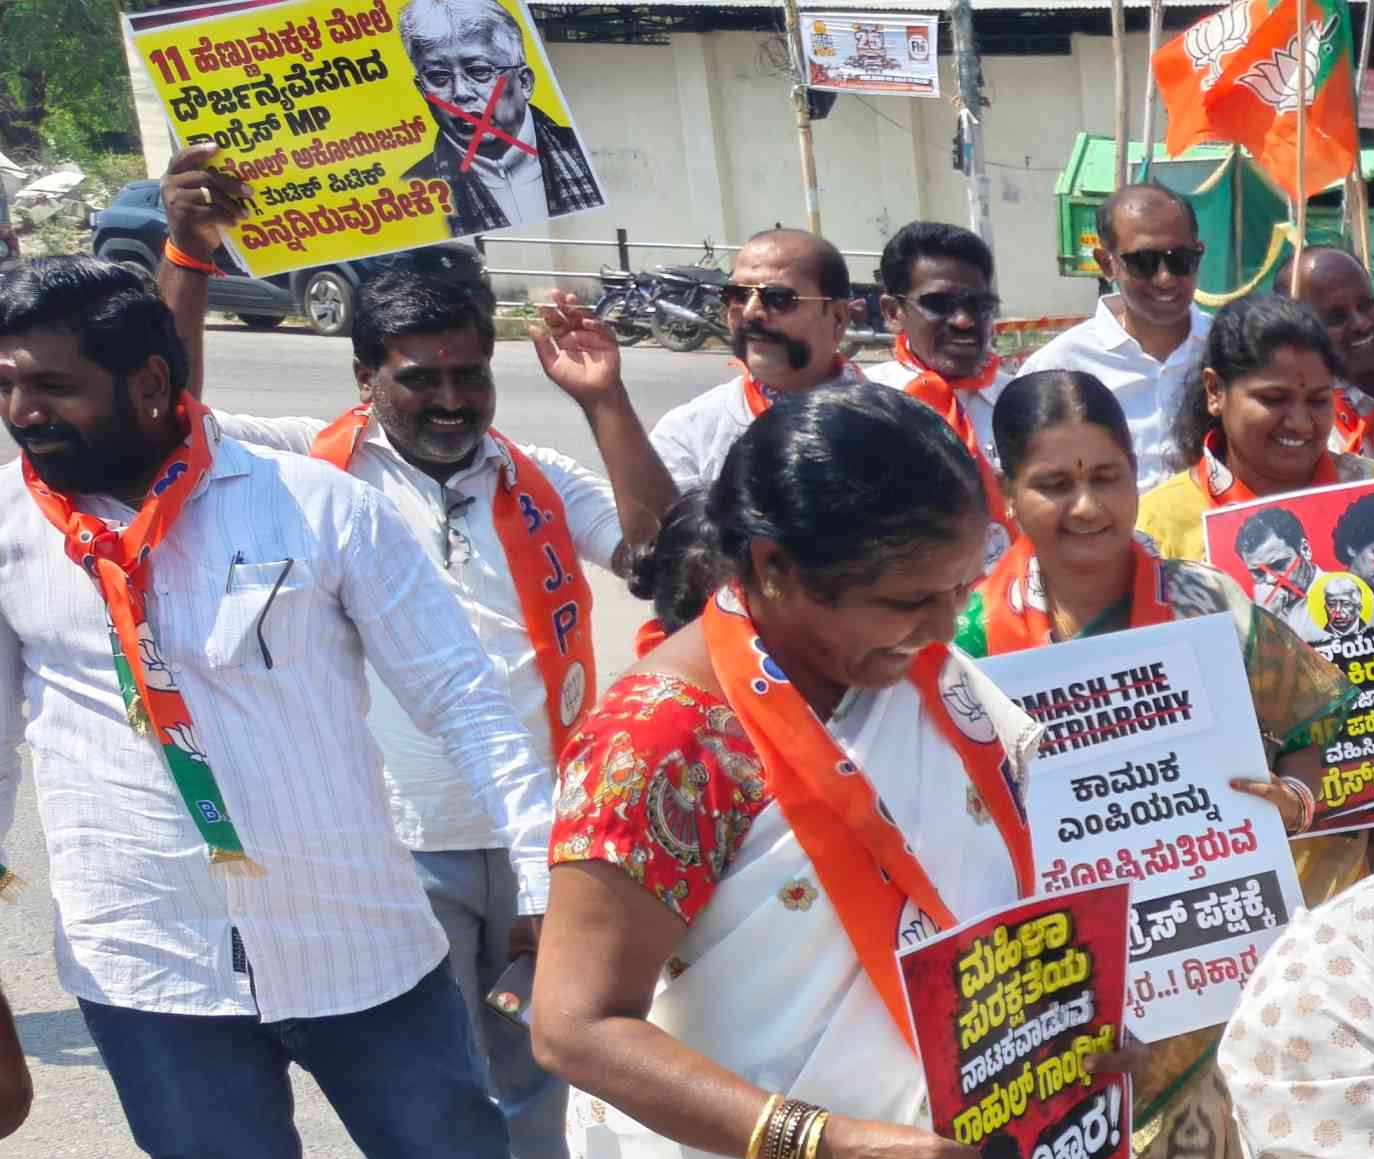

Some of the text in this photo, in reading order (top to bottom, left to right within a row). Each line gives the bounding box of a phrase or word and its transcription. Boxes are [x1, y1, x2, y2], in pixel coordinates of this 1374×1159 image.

[150, 46, 191, 84] 11
[283, 106, 331, 137] MP
[1011, 661, 1171, 723] MASH THE
[1038, 690, 1193, 759] ATRIARCHY
[1070, 752, 1182, 803] ಕಾಮುಕ
[959, 912, 1070, 998] ಮಹಿಳಾ
[953, 1061, 1034, 1145] ರಾಹುಲ್
